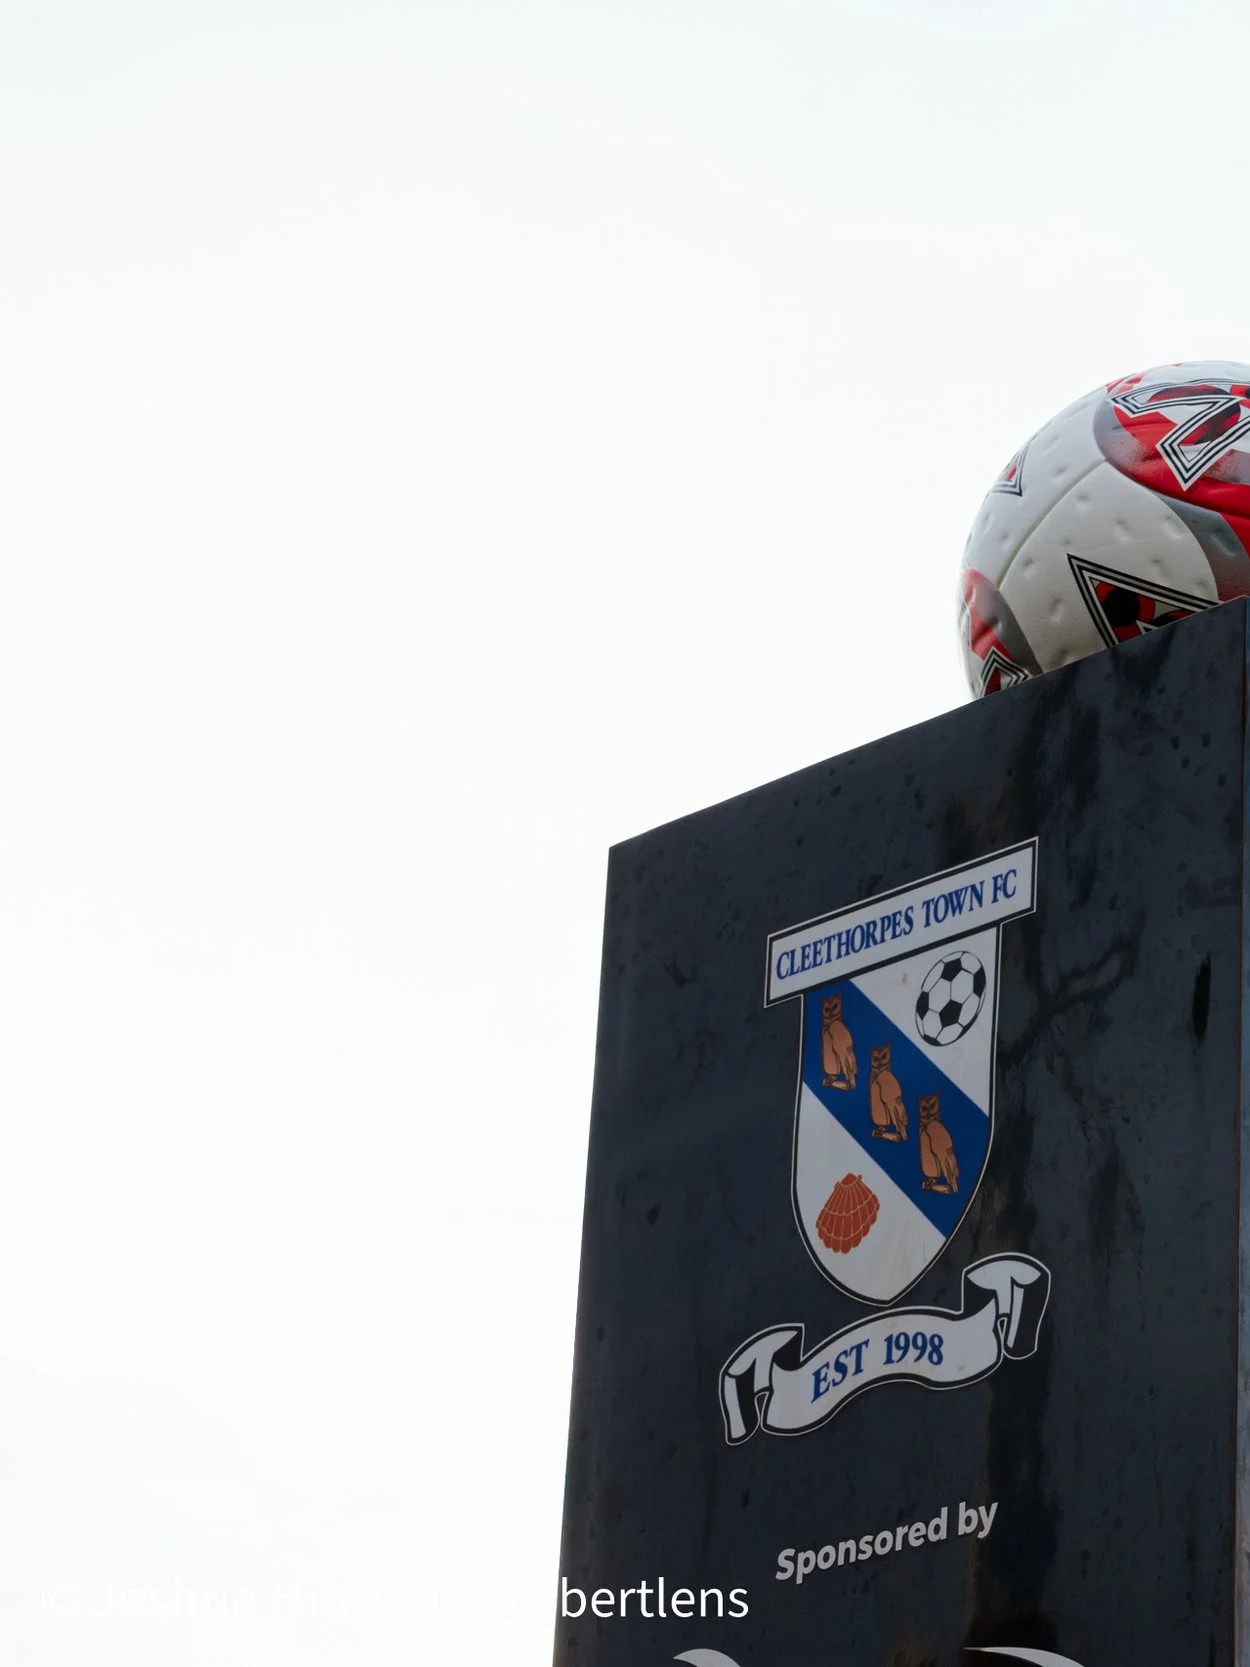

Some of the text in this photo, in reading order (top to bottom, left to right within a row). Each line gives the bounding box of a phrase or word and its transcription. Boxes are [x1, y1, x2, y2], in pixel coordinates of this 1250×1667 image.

[776, 868, 1017, 980] CLEETHORPES TOWN FC
[811, 1331, 945, 1403] EST 1998
[775, 1501, 999, 1585] Sponsored by
